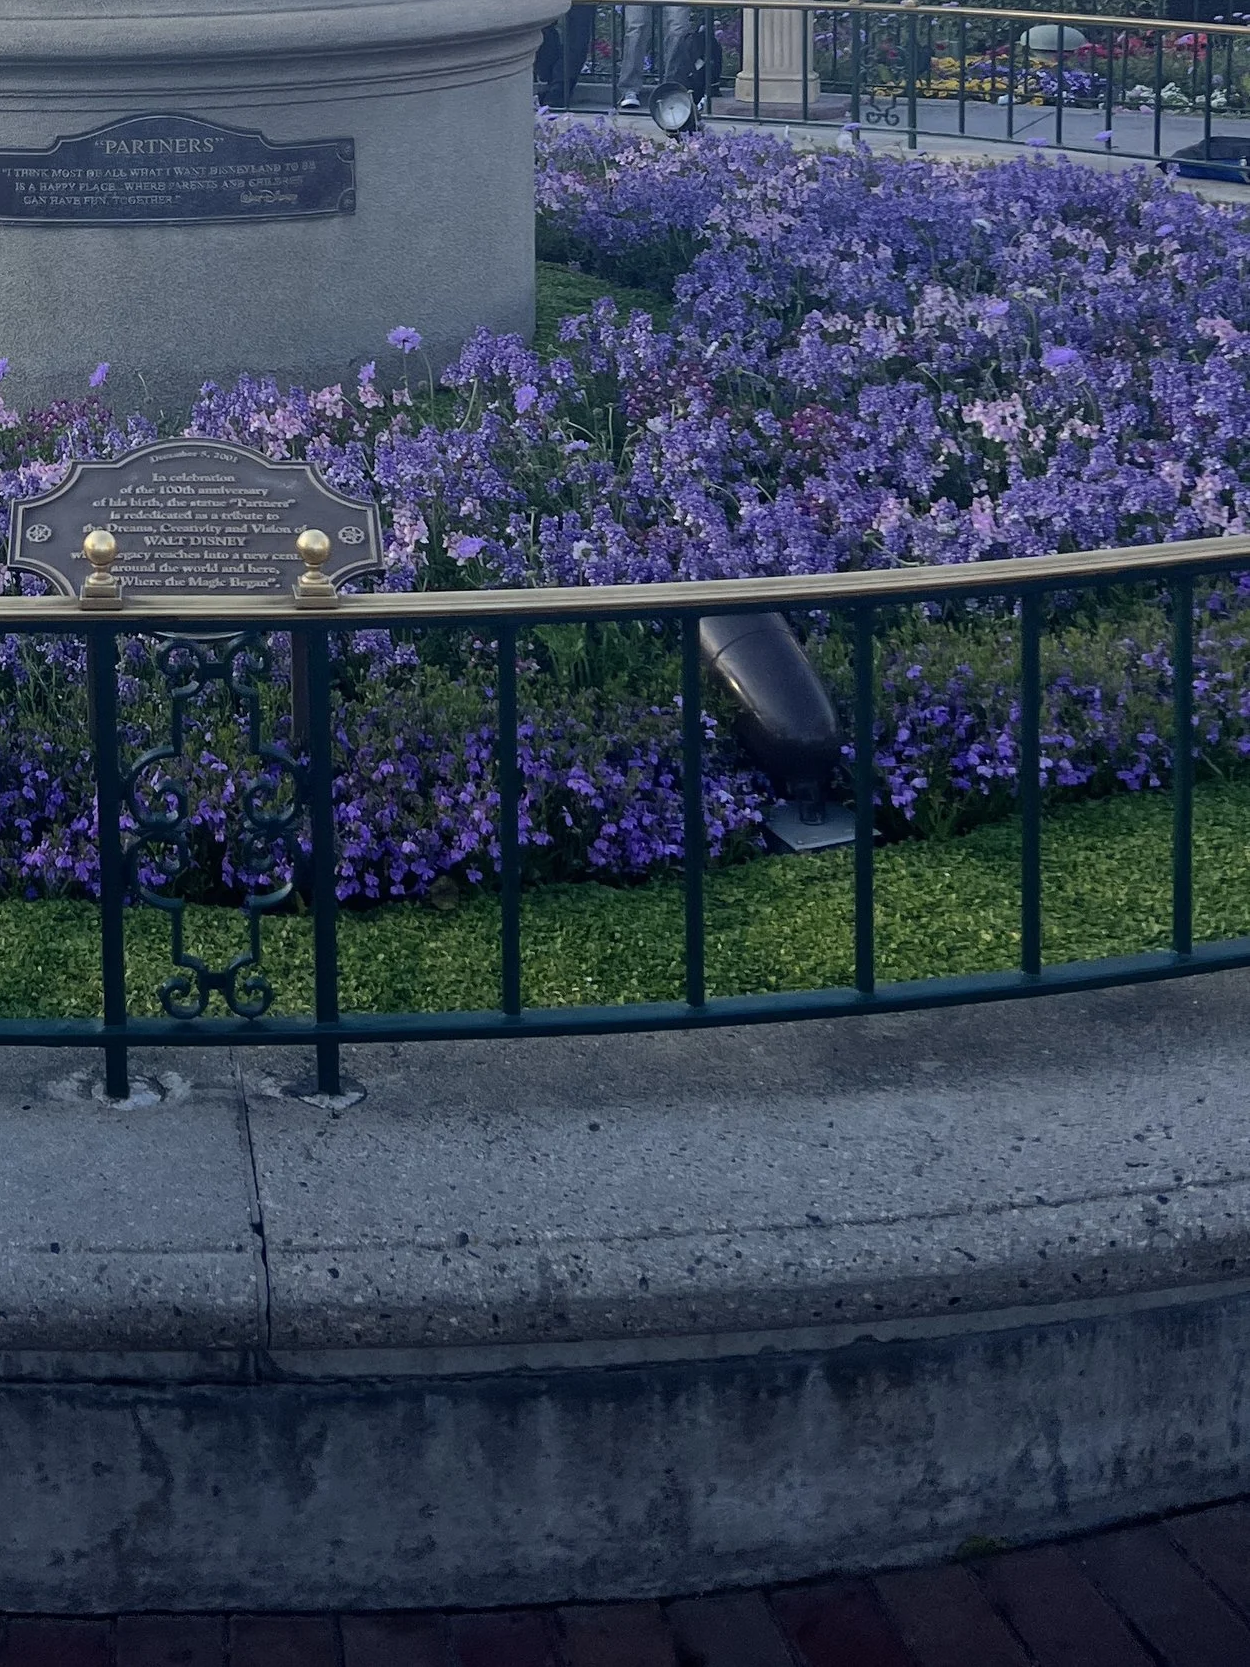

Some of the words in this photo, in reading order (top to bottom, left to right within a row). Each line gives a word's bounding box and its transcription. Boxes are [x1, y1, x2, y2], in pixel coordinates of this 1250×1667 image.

[14, 168, 49, 178] THINK
[51, 168, 82, 178] MOST
[86, 168, 101, 178] OF
[105, 168, 127, 178] ALL
[130, 168, 161, 177] WHAT
[166, 167, 170, 175] I
[174, 166, 206, 175] WANT
[209, 164, 281, 175] DISNEYLAND
[285, 162, 298, 171] TO
[15, 182, 25, 191] IS
[28, 182, 36, 191] A
[40, 182, 76, 191] HAPPY
[124, 182, 165, 191] WHERE
[169, 180, 218, 191] PARENTS
[221, 179, 245, 188] AND
[24, 196, 47, 205] CAN
[50, 196, 80, 205] HAVE
[150, 450, 197, 463] December
[152, 473, 167, 482] In
[169, 472, 235, 482] celebration
[119, 484, 133, 494] of
[135, 484, 155, 494] the
[159, 485, 196, 494] 100th
[198, 485, 269, 496] anniversary
[92, 497, 107, 507] of
[109, 497, 127, 507] his
[130, 497, 164, 508] birth,
[166, 497, 187, 507] the
[189, 498, 227, 507] statue
[123, 510, 193, 520] rededicated
[194, 512, 208, 520] as
[210, 512, 219, 520] a
[221, 510, 264, 520] tribute
[266, 511, 280, 520] to
[82, 523, 103, 533] the
[106, 523, 157, 533] Dreams,
[160, 523, 223, 534] Creativity
[225, 524, 248, 533] and
[251, 524, 292, 534] Vision
[294, 524, 307, 534] of
[143, 536, 187, 546] WALT
[189, 536, 246, 546] DISNEY
[114, 551, 151, 561] egacy
[154, 550, 201, 559] reaches
[203, 550, 229, 559] into
[242, 552, 269, 560] new
[110, 563, 156, 572] around
[159, 563, 179, 572] the
[182, 563, 218, 573] world
[221, 563, 245, 573] and
[248, 563, 280, 574] here,
[164, 576, 186, 586] the
[188, 576, 226, 588] Magic
